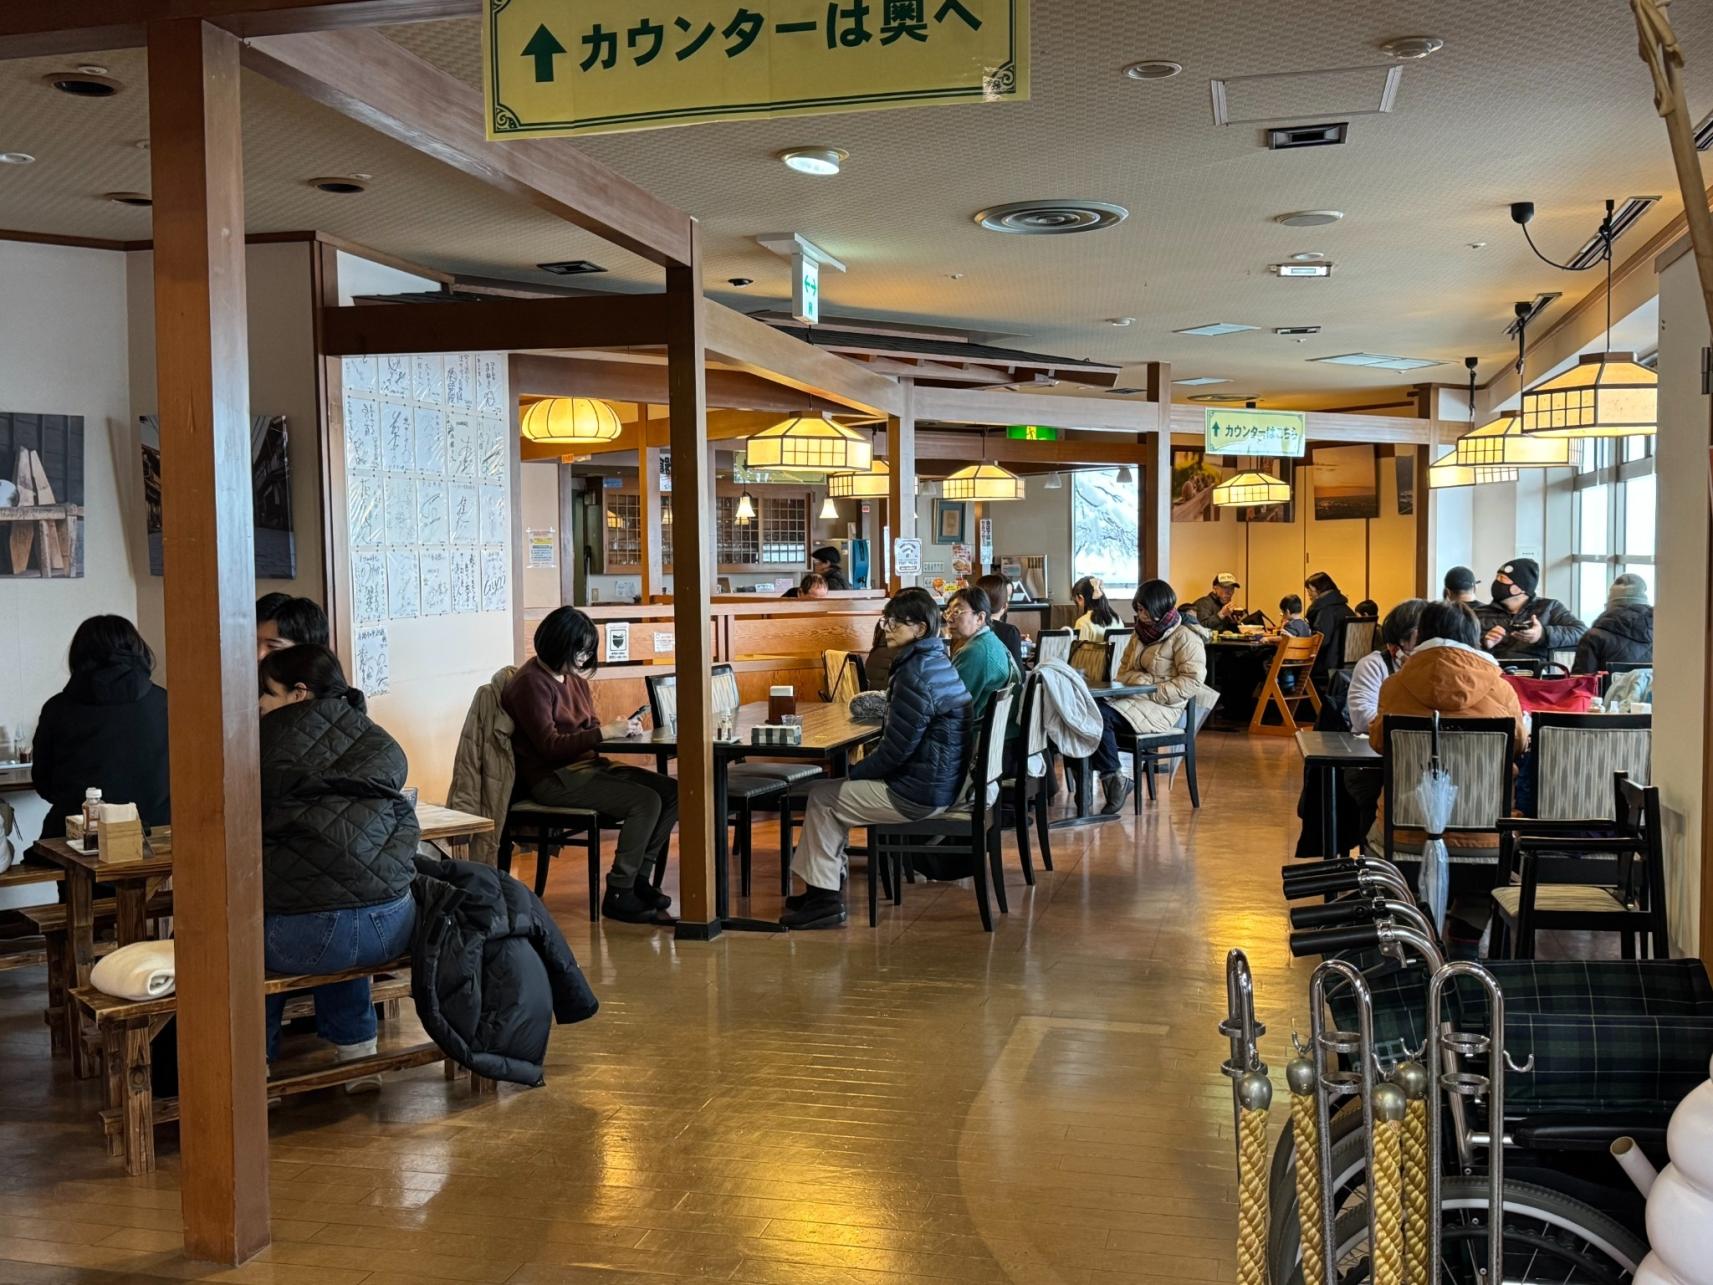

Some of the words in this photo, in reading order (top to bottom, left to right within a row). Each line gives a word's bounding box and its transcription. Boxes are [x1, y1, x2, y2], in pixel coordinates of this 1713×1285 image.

[579, 0, 982, 72] カウンターは奥へ
